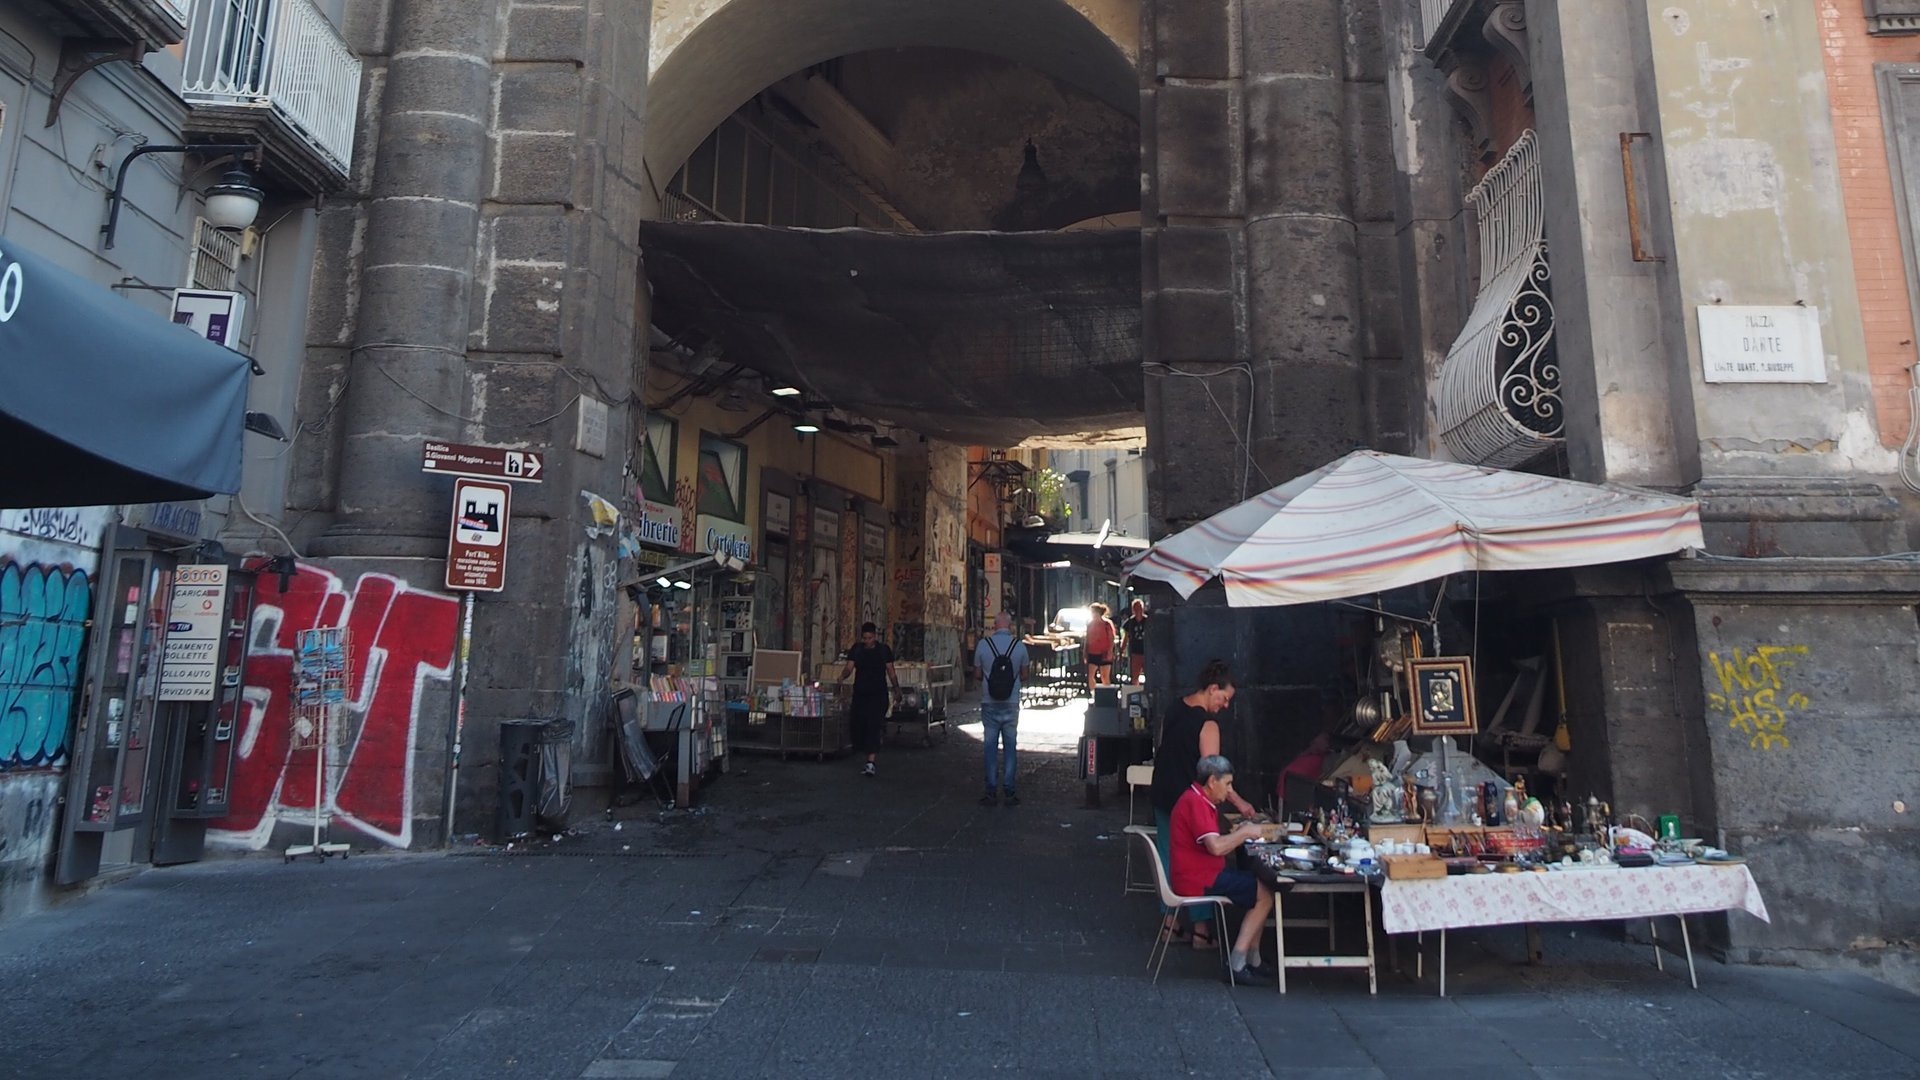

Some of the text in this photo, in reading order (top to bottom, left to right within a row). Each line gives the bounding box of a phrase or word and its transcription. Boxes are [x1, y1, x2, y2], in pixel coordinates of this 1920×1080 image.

[1742, 336, 1783, 353] DANTE
[426, 443, 449, 452] Basilica
[457, 455, 484, 465] Maggiore
[639, 510, 678, 544] ibrerie
[187, 670, 211, 678] AUTO
[192, 688, 211, 696] FAX
